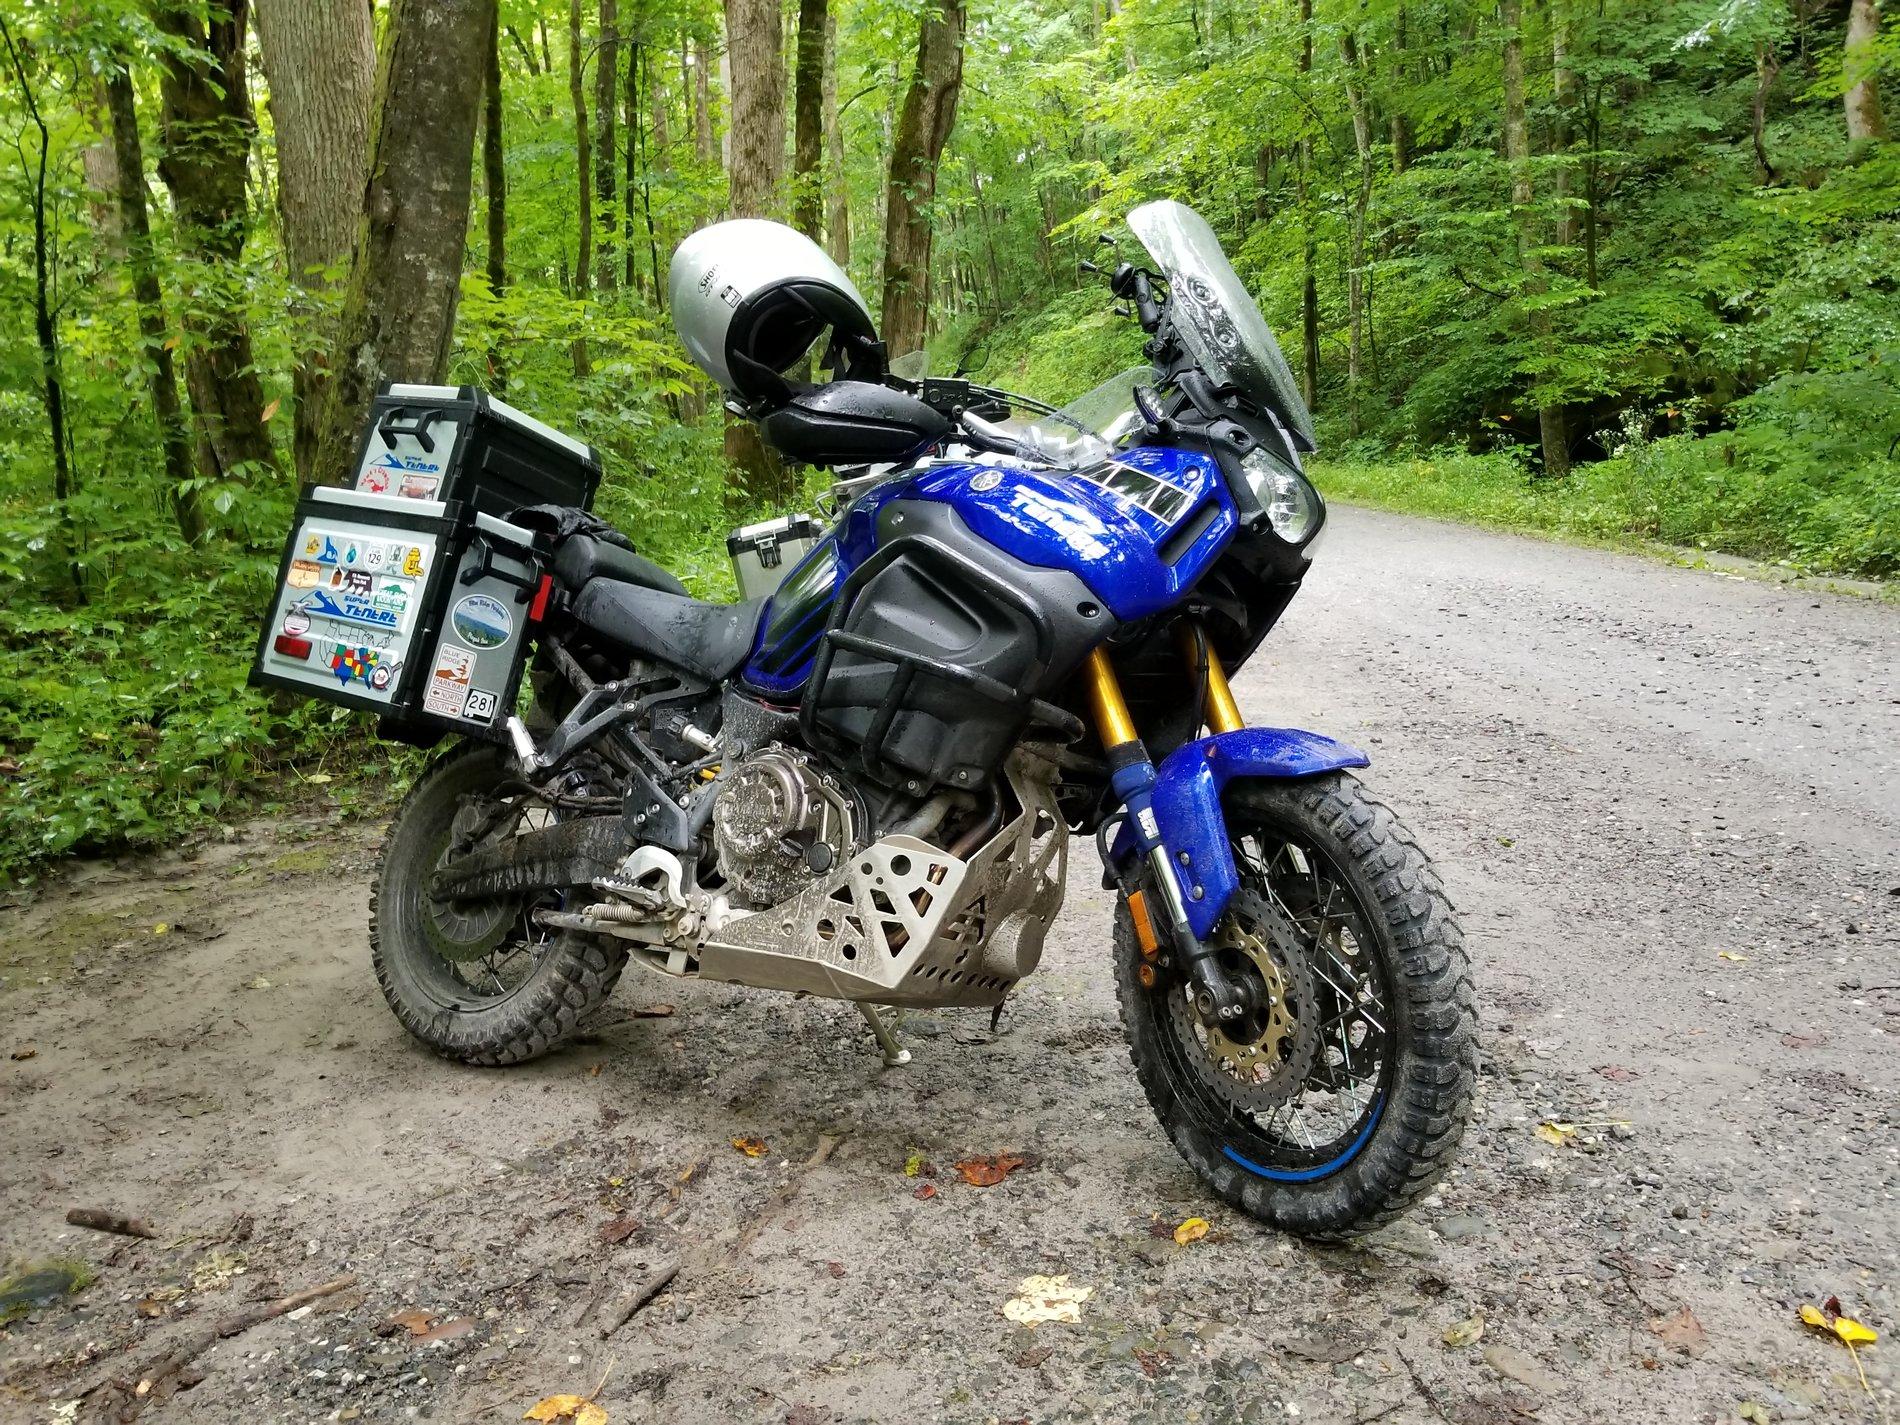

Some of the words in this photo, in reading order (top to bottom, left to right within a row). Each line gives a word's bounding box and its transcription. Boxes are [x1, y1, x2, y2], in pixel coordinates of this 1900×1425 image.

[699, 264, 718, 290] SHO
[367, 553, 382, 565] 129
[343, 595, 370, 605] SUPER
[345, 604, 397, 623] TENERE
[443, 647, 460, 658] BLUE
[434, 677, 466, 692] PARKWAY
[440, 691, 463, 702] NORTH
[427, 700, 450, 712] SOUTH
[468, 694, 493, 713] 281
